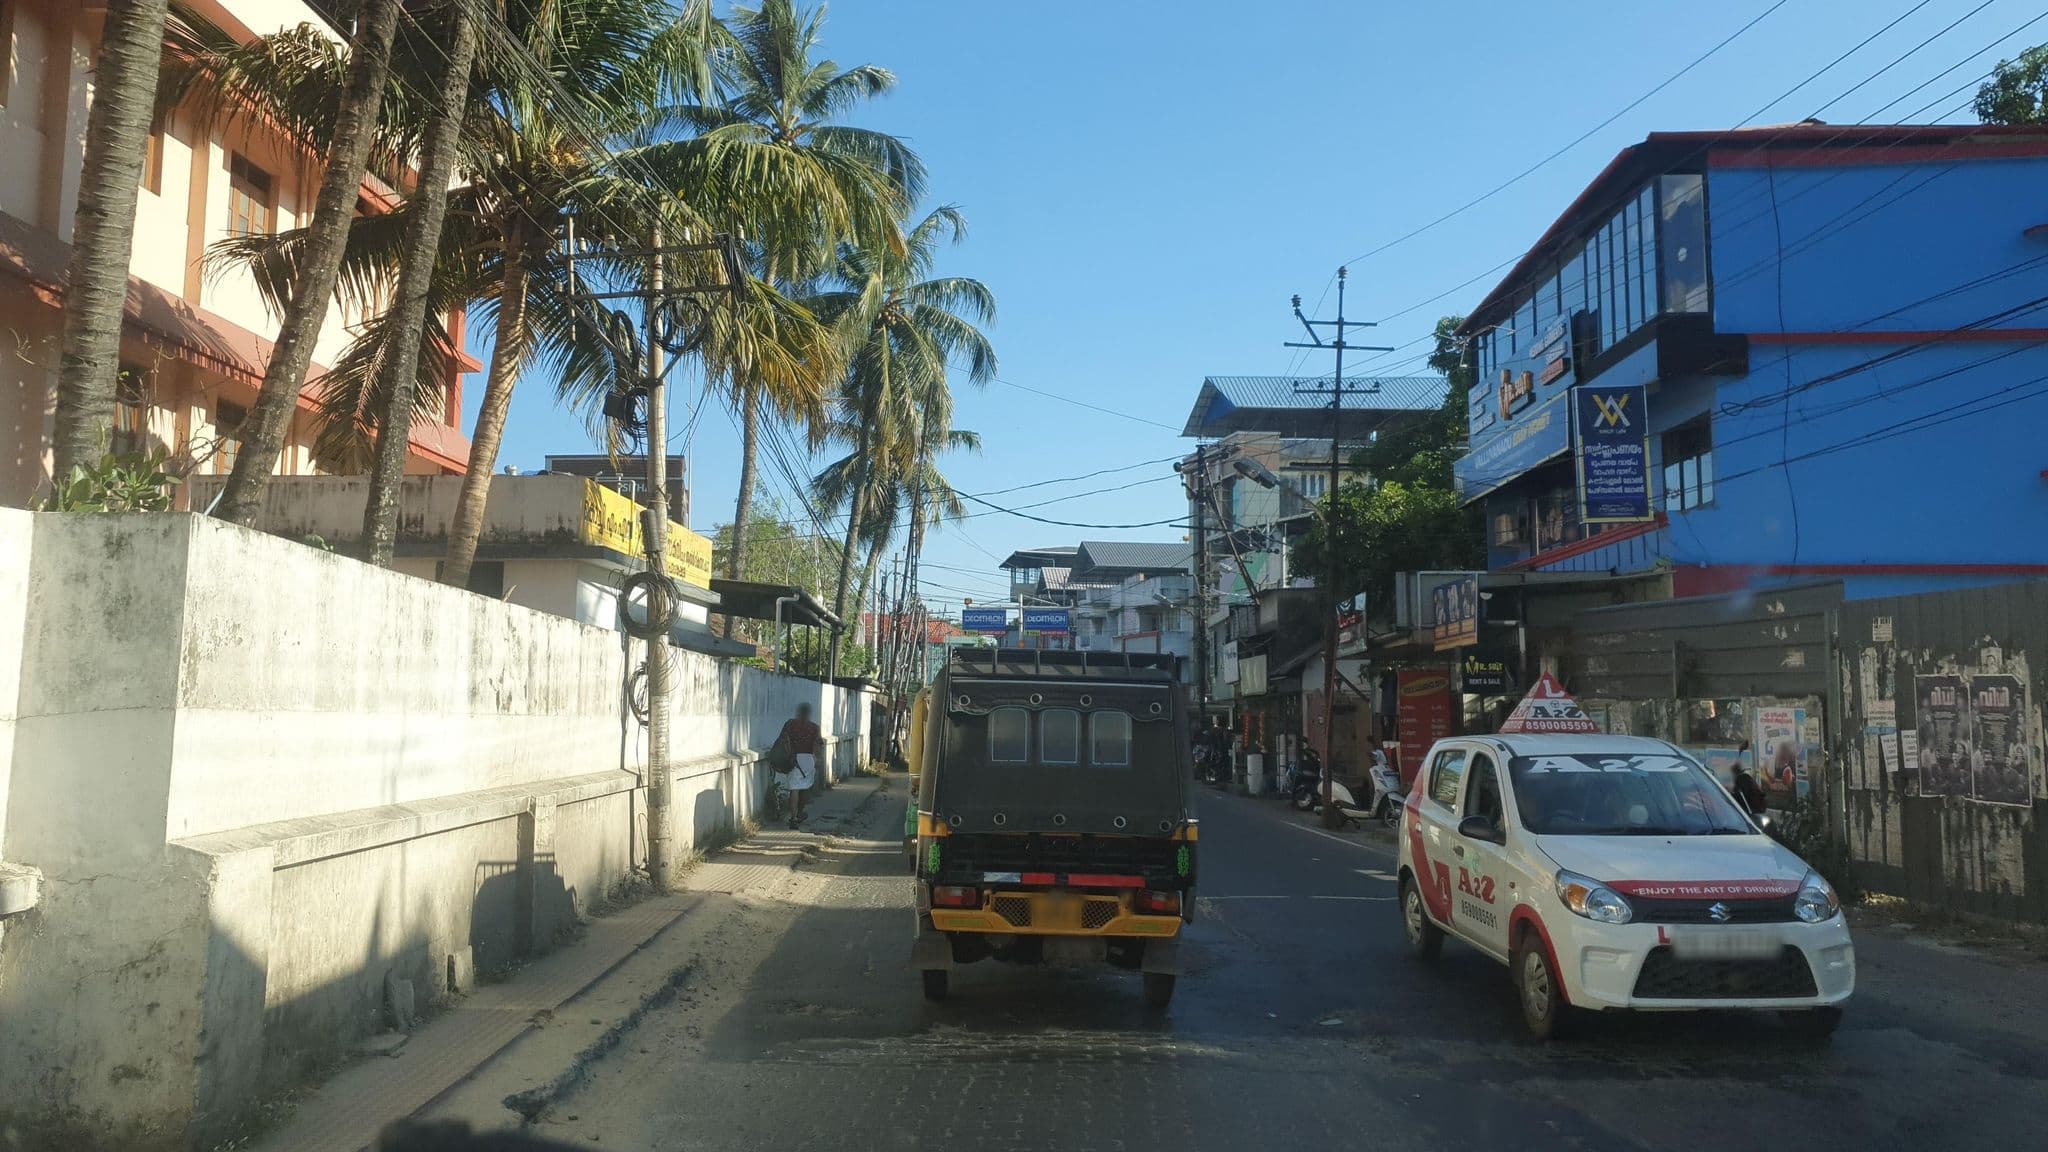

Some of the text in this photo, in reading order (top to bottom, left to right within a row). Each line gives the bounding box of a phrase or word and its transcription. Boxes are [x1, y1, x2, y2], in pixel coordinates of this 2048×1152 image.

[1543, 679, 1566, 698] L
[1532, 705, 1583, 718] A2Z
[1526, 721, 1594, 730] 8590085591
[1528, 755, 1689, 773] A2Z
[1458, 866, 1496, 904] A2Z
[1680, 886, 1698, 894] THE
[1703, 886, 1725, 894] ART
[1728, 886, 1742, 894] OF
[1657, 925, 1671, 945] L
